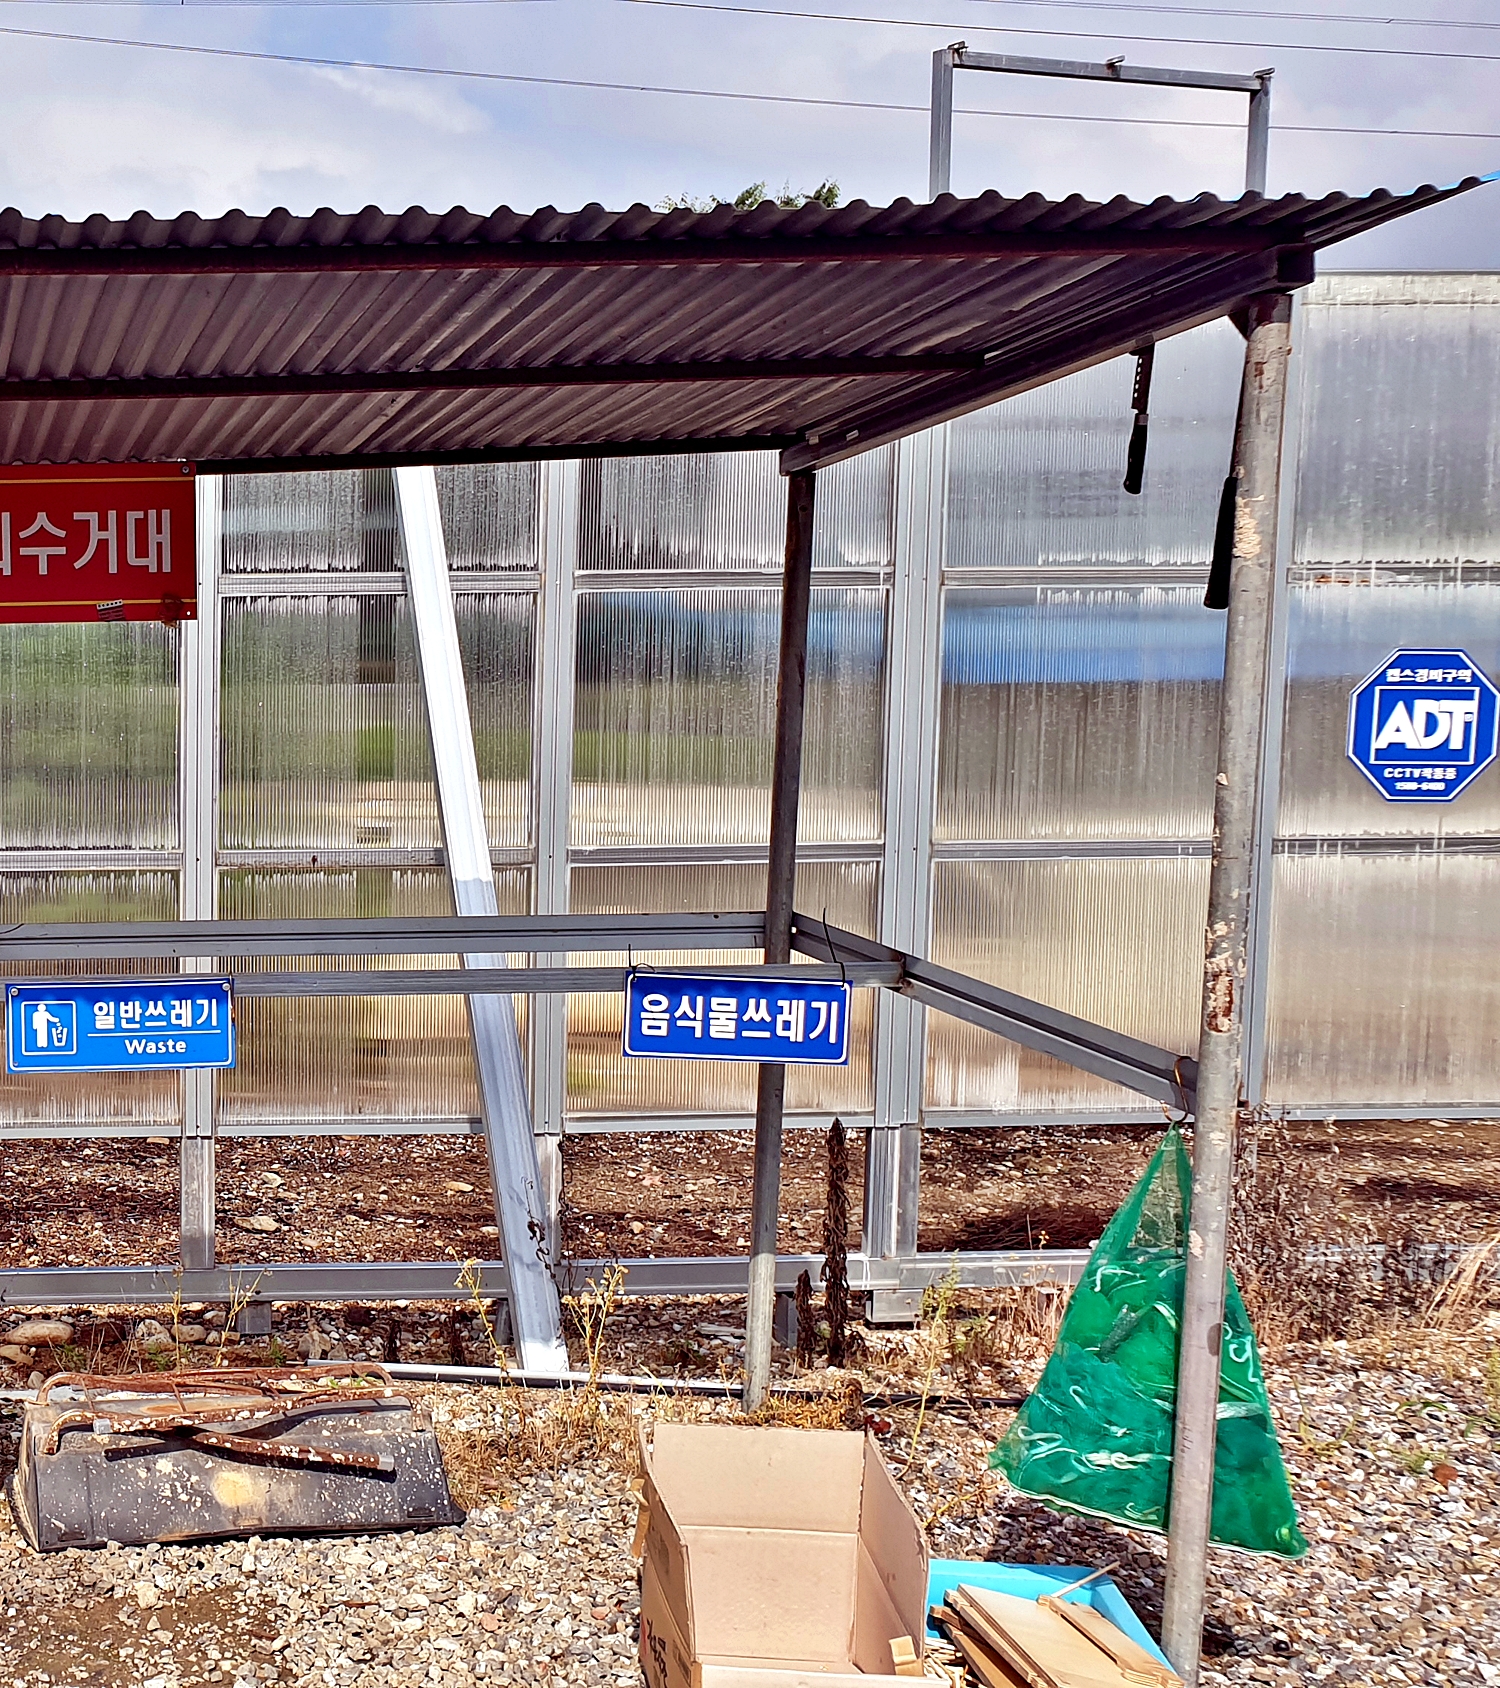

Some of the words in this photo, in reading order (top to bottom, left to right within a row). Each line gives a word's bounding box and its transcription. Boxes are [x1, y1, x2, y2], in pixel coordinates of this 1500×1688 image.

[1374, 699, 1476, 750] ADT
[93, 999, 219, 1030] 일반쓰레기
[640, 992, 839, 1044] 음식물쓰레기
[123, 1037, 187, 1055] Waste
